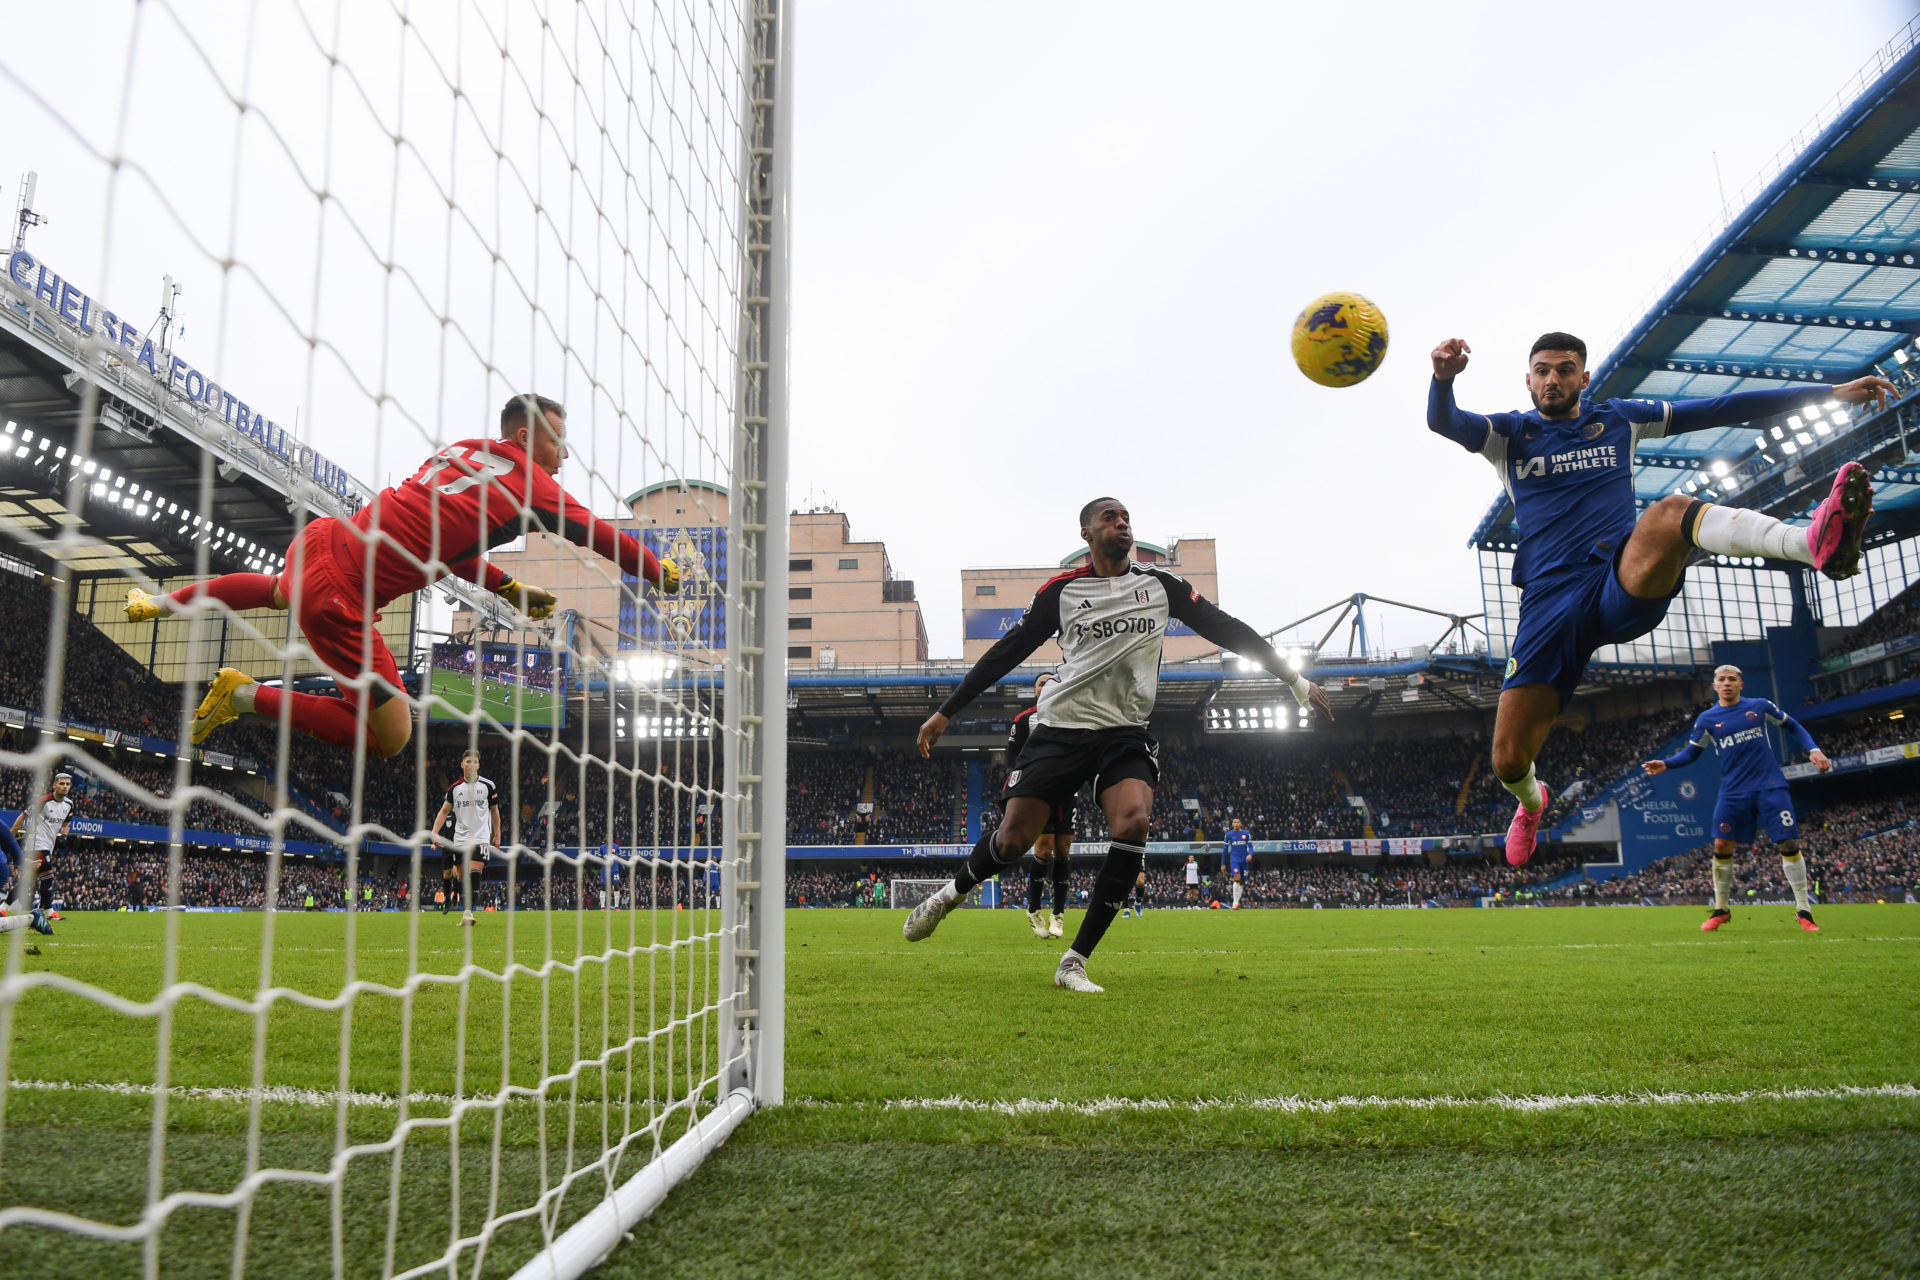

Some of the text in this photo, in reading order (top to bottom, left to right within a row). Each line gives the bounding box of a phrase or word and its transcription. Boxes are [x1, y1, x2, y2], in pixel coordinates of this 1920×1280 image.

[10, 252, 348, 496] CHELSEA FOOTBALL CLUB
[1551, 445, 1617, 464] INFINITE
[1551, 456, 1617, 474] ATHLETE
[646, 584, 717, 597] AYLLE
[1091, 617, 1156, 639] SBOTOP
[1733, 726, 1763, 739] INFINITE
[1735, 732, 1764, 744] ATHLETE
[1633, 801, 1678, 810] CHELSEA
[1643, 811, 1697, 824] FOOTBALL
[1780, 810, 1794, 827] 8
[72, 821, 103, 833] LONDON
[1675, 824, 1705, 836] CLUB
[235, 838, 245, 846] THE
[246, 839, 260, 848] PRIDE
[266, 841, 287, 851] LOON
[1293, 843, 1317, 851] LOND
[923, 847, 959, 856] TAMBLING
